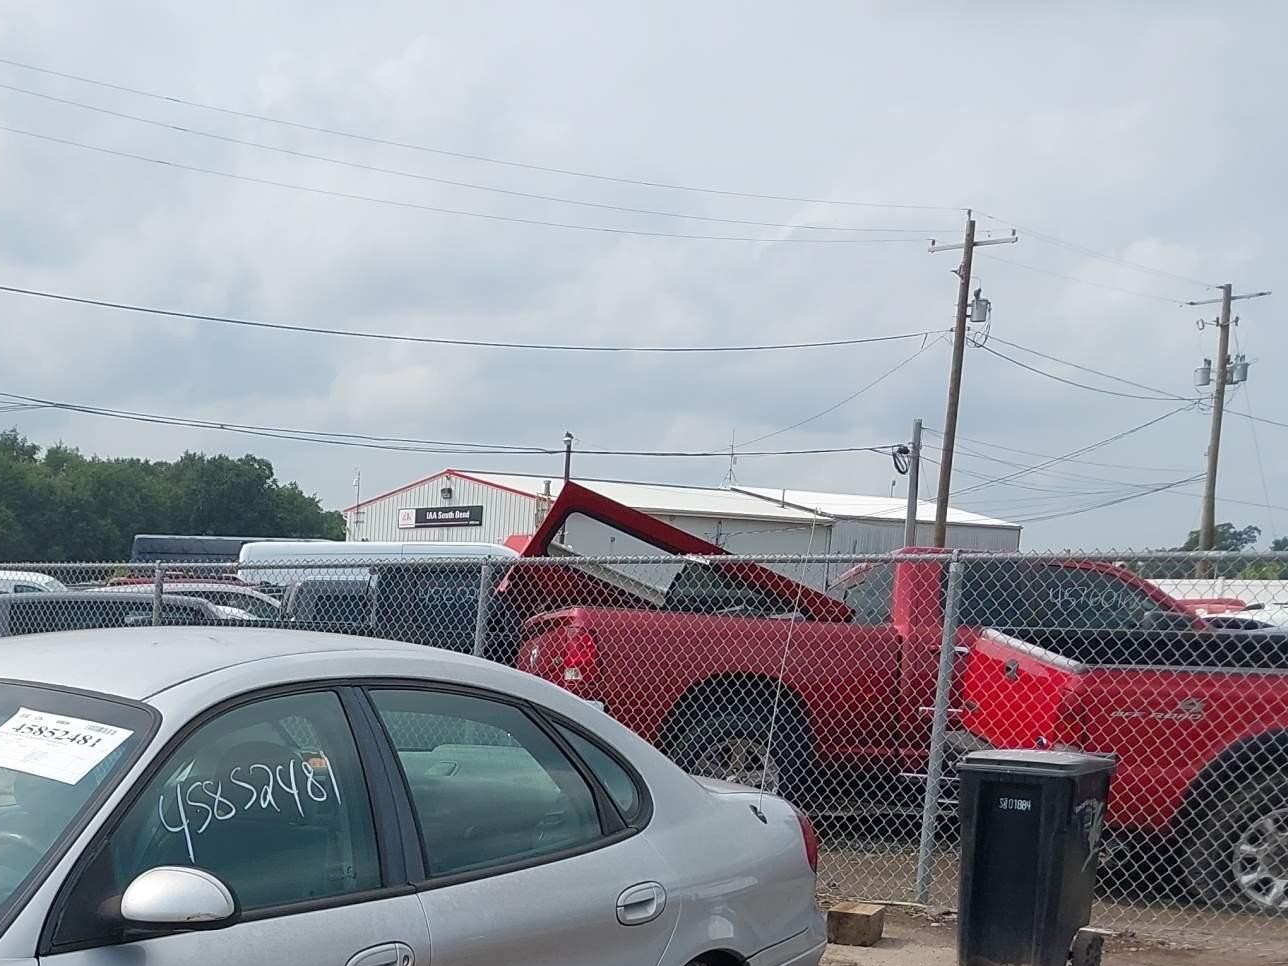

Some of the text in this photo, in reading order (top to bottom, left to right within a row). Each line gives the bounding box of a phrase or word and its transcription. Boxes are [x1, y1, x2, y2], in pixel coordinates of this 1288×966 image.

[426, 511, 437, 520] IAA
[438, 511, 455, 520] South
[12, 722, 104, 749] 45852481
[159, 750, 342, 864] 45852481
